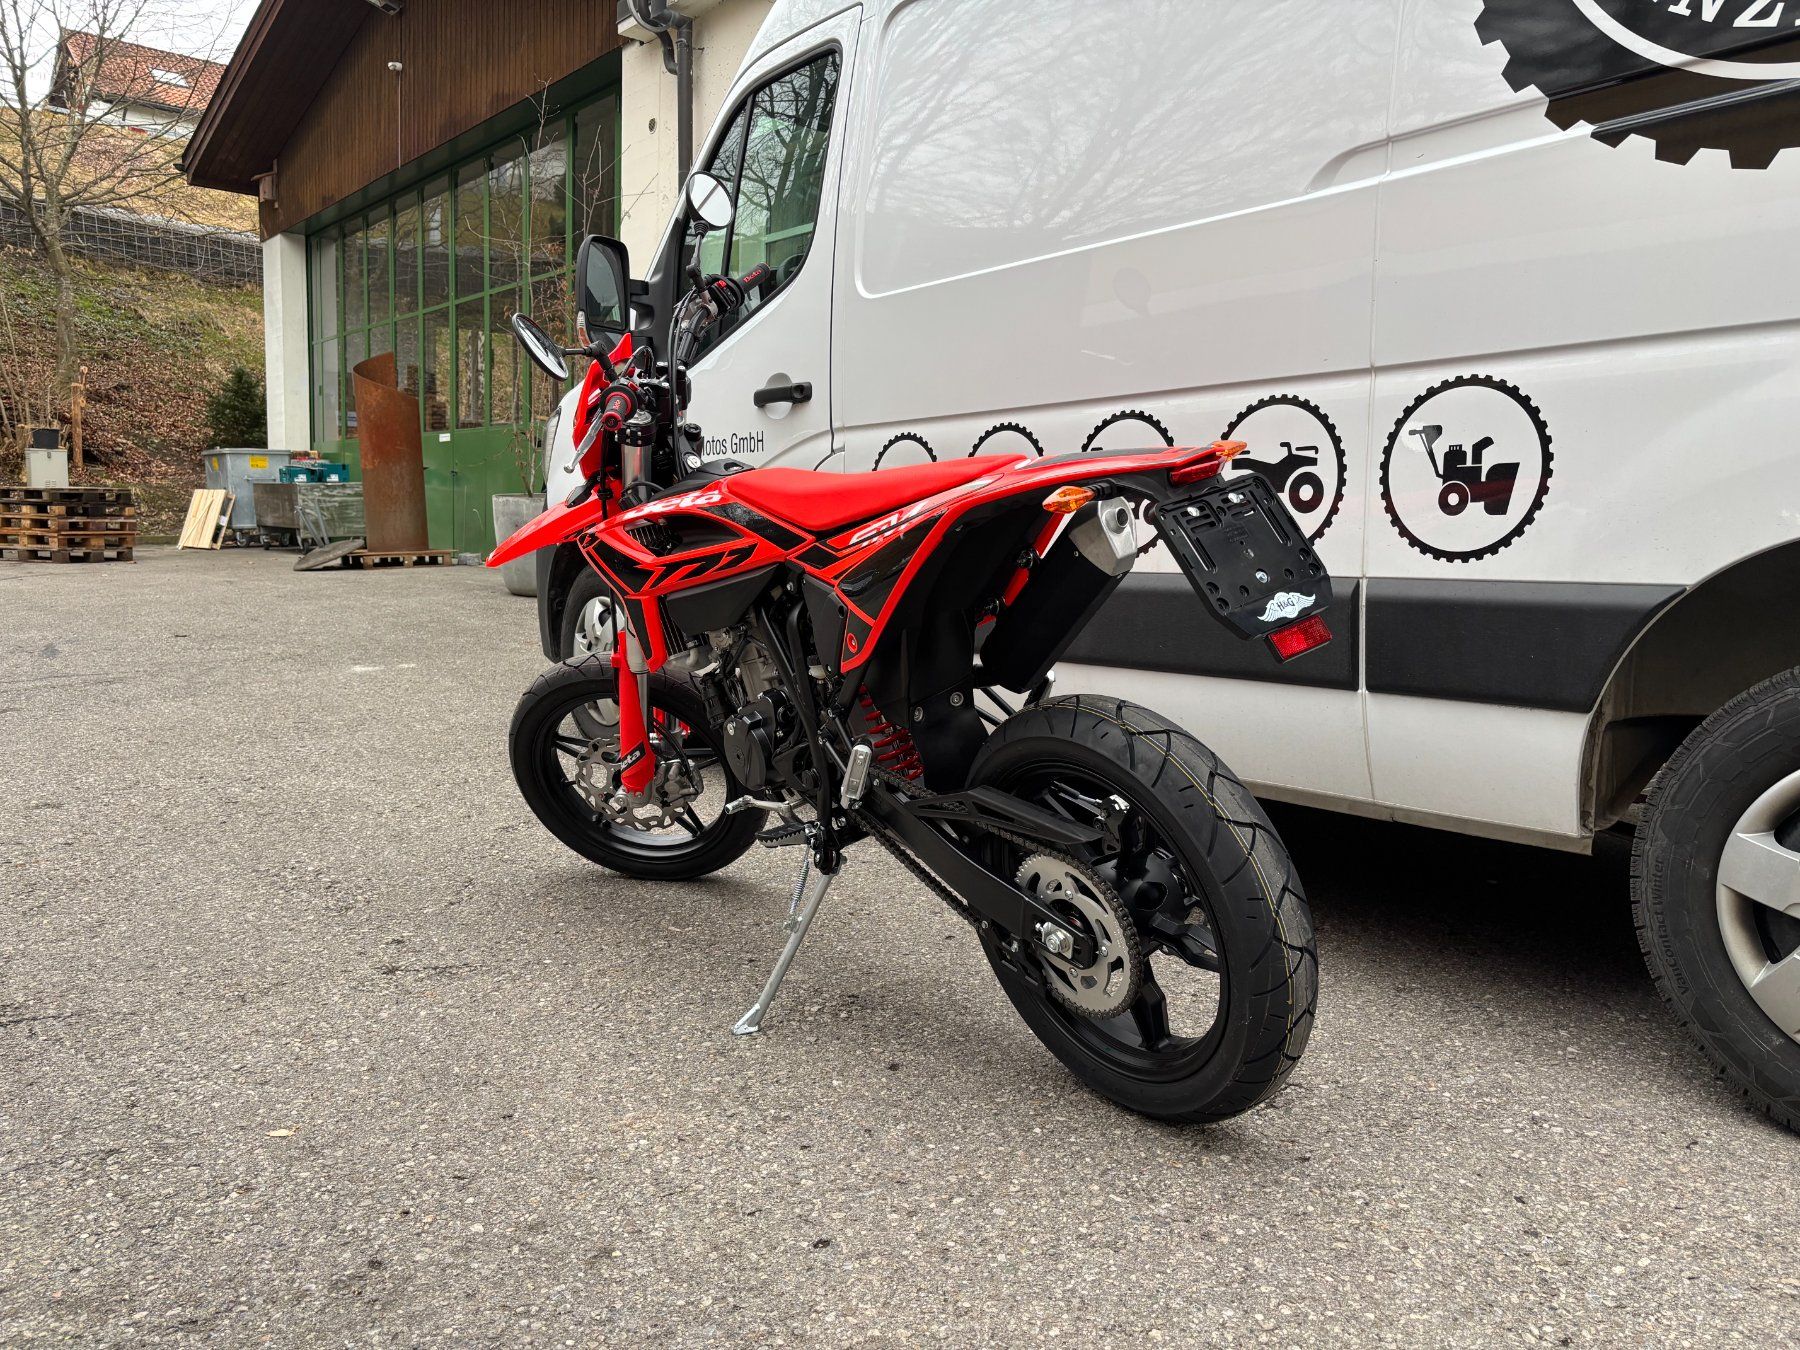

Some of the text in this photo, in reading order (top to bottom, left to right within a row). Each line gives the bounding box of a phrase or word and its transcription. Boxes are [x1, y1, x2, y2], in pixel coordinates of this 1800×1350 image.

[730, 430, 764, 455] GmbH
[1275, 597, 1296, 612] H&G
[1651, 859, 1689, 996] VanContact Winter
